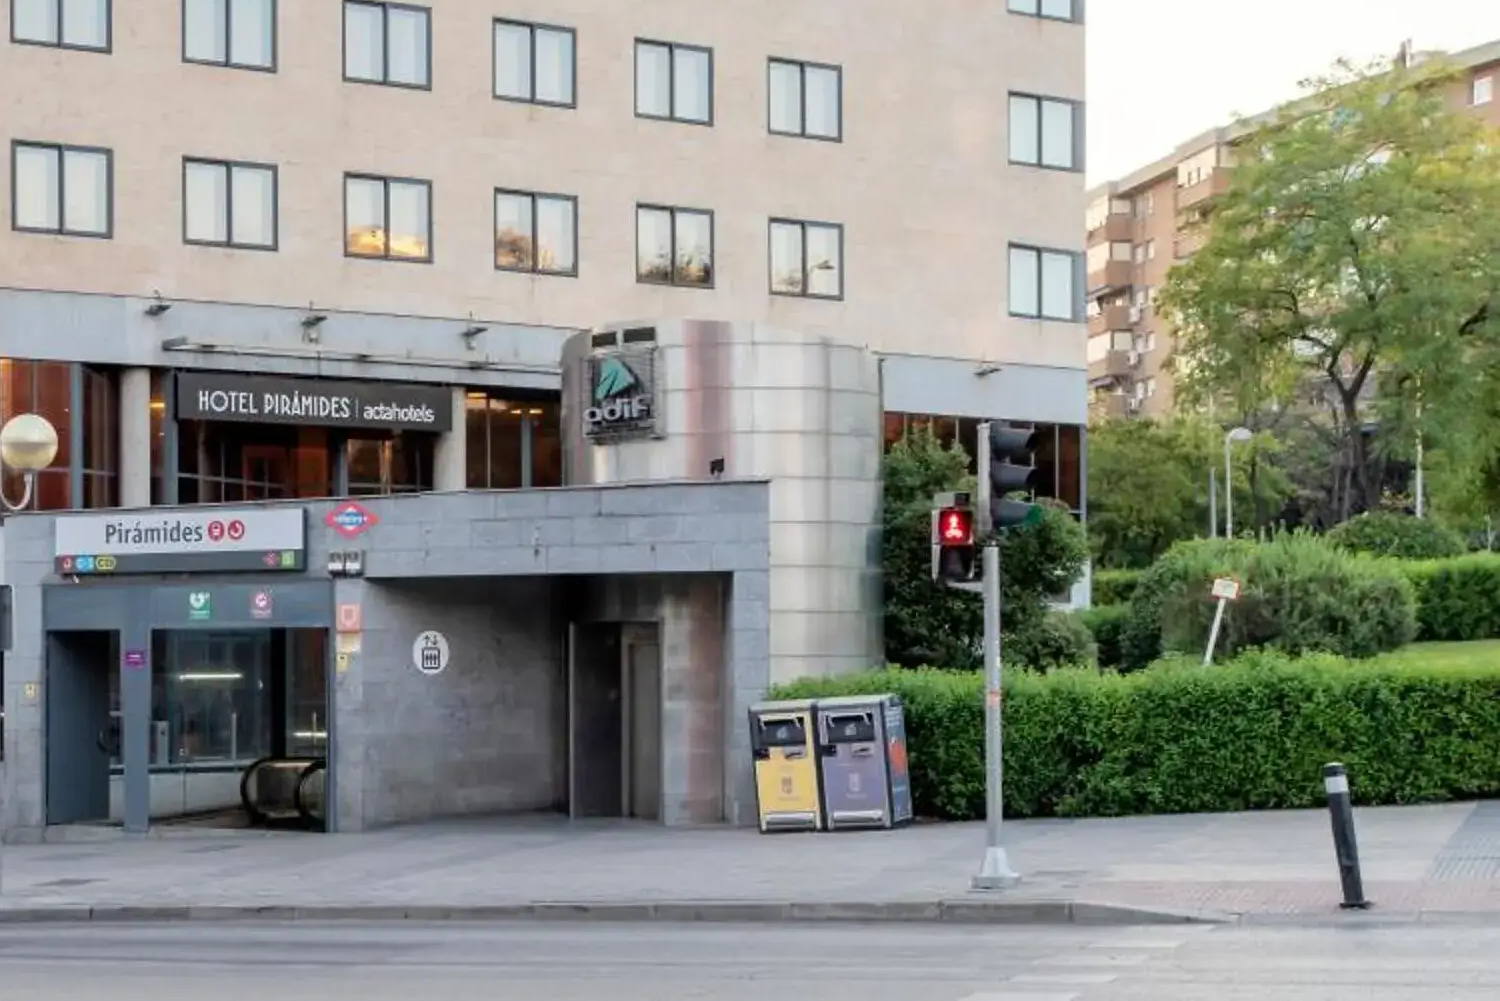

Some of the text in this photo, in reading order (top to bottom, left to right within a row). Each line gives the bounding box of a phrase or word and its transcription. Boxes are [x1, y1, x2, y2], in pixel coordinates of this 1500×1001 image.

[199, 390, 436, 424] HOTEL PIRÁMIDES actahotels
[105, 520, 203, 545] Pirámides
